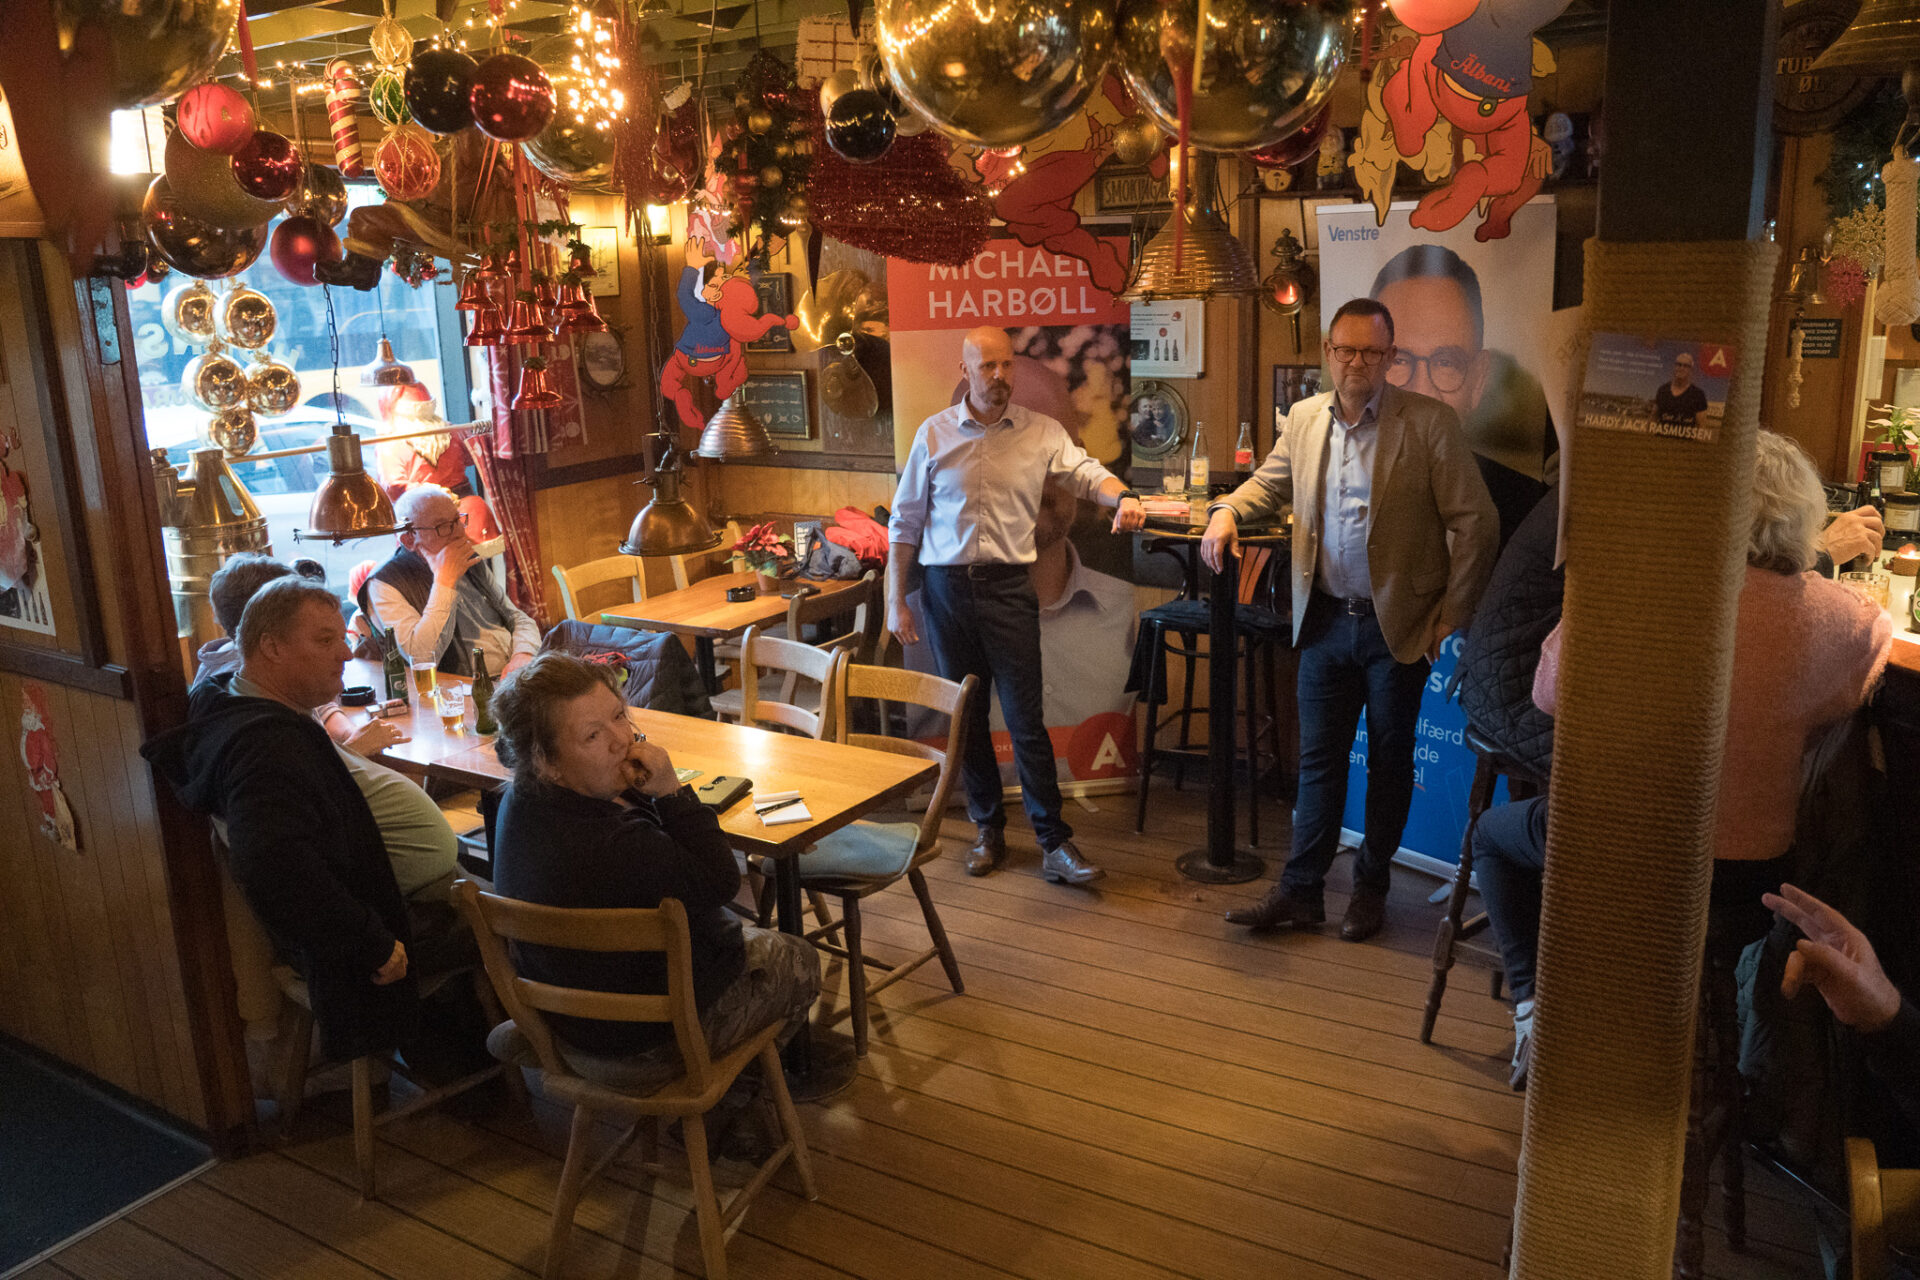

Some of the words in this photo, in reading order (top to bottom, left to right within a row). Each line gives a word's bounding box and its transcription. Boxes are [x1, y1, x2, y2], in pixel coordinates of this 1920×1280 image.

[1328, 224, 1380, 242] Venstre
[928, 250, 1091, 281] MICHAEL
[928, 286, 1096, 319] HARBØLL
[1708, 347, 1728, 369] A
[1584, 413, 1621, 431] HARDY
[1621, 418, 1648, 433] JACK
[1648, 421, 1713, 441] RASMUSSEN
[1416, 717, 1464, 746] lfærd
[1090, 732, 1127, 771] A
